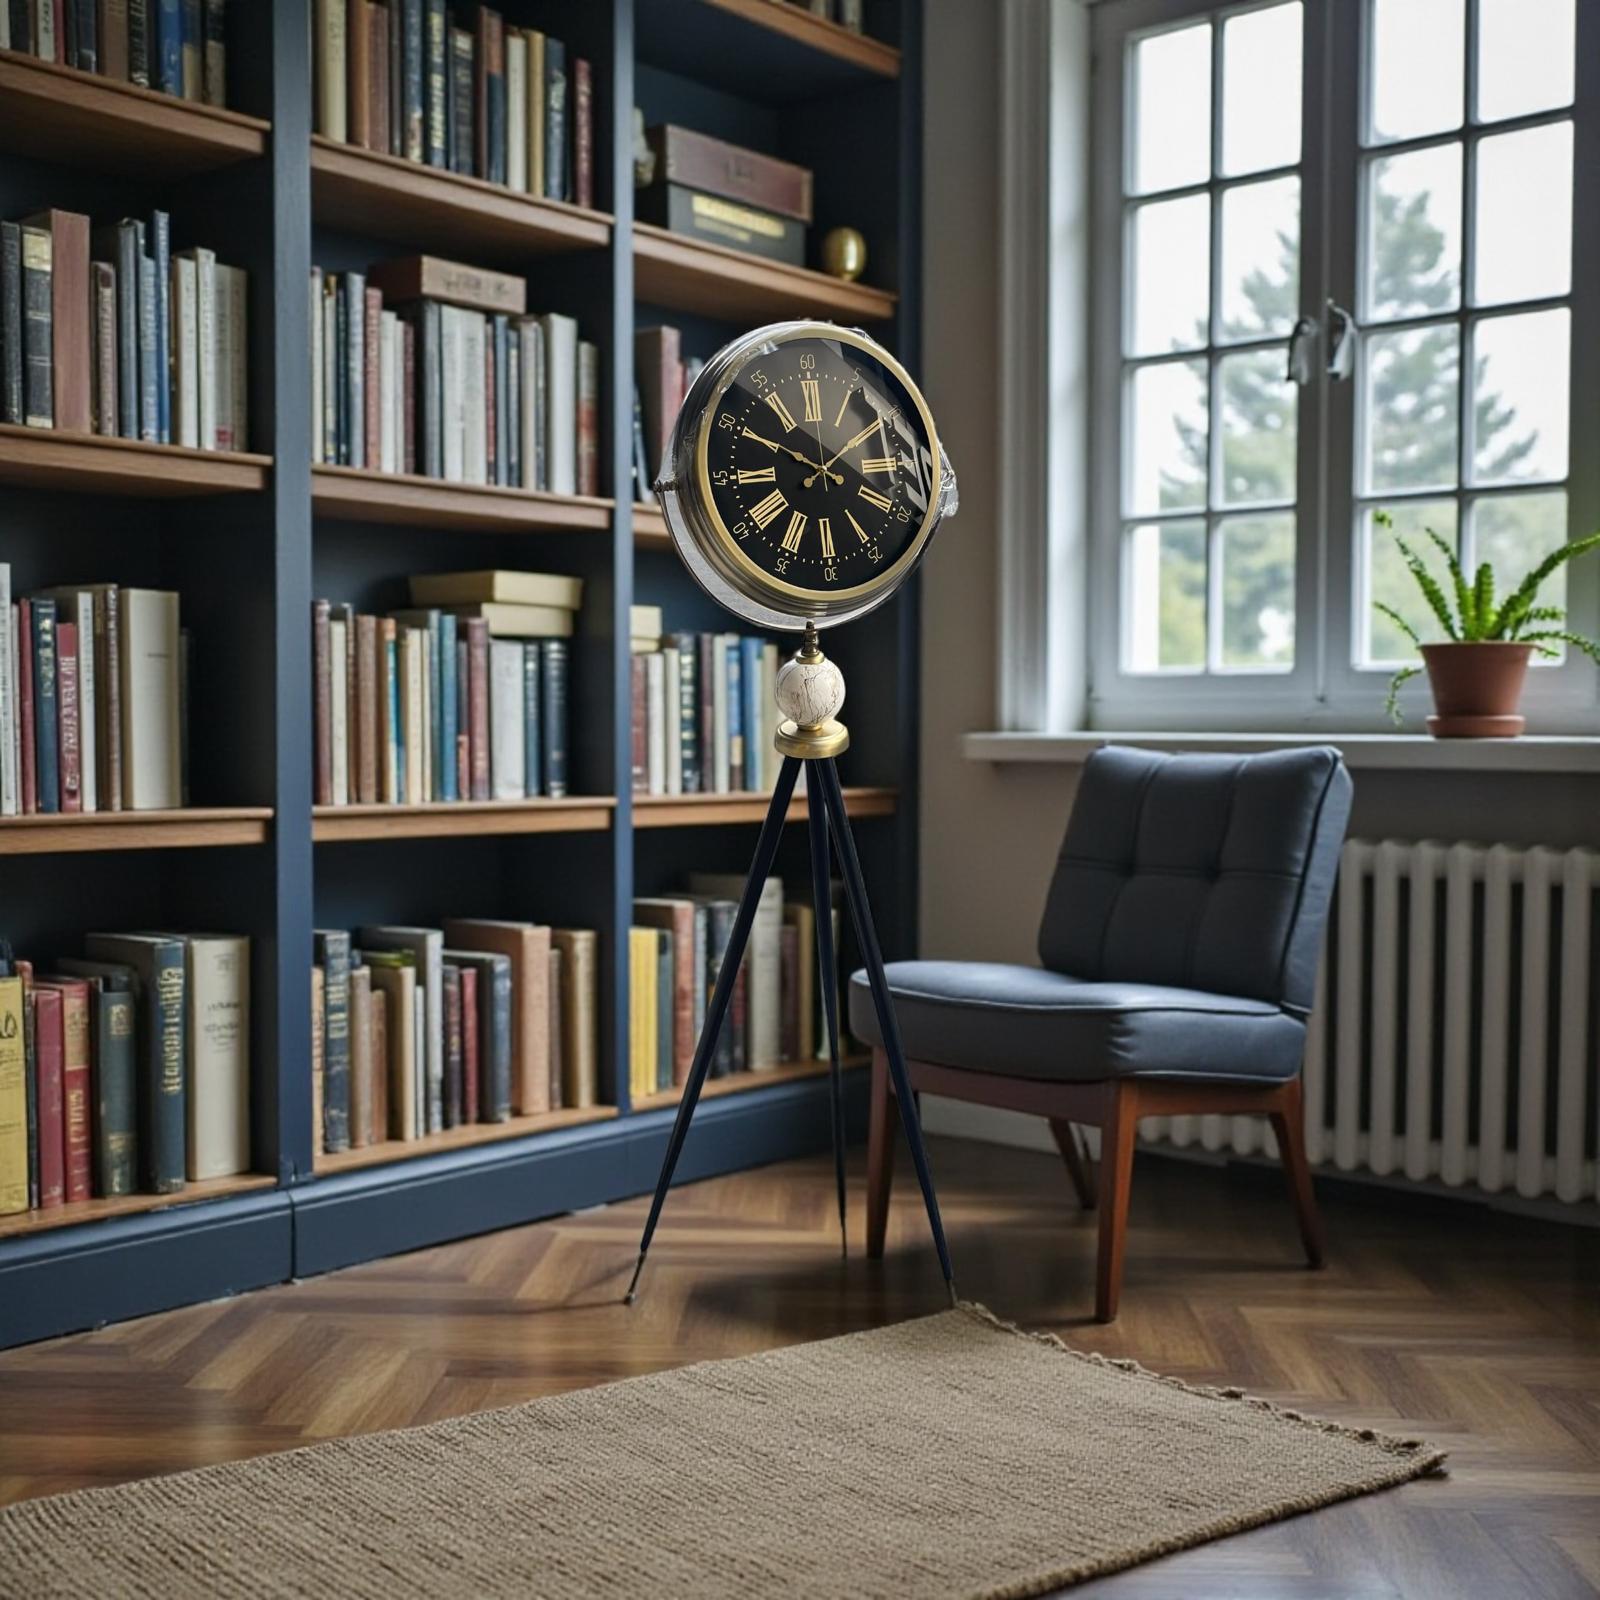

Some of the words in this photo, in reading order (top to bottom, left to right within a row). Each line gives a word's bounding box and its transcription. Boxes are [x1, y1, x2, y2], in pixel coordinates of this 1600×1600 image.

[800, 354, 815, 370] 60
[751, 370, 767, 388] 55
[852, 367, 861, 381] 5
[800, 380, 822, 422] XII
[834, 389, 852, 428] I
[764, 391, 797, 433] XI
[718, 413, 735, 432] 50
[742, 426, 780, 453] X
[861, 457, 897, 474] III
[712, 470, 728, 486] 45
[737, 466, 777, 485] IX
[749, 488, 789, 530] VIII
[896, 506, 912, 523] 20
[733, 522, 750, 540] 40
[781, 510, 808, 554] VII
[844, 509, 870, 544] V
[818, 517, 836, 558] VI
[867, 546, 883, 564] 25
[774, 558, 790, 575] 35
[824, 565, 839, 582] 30
